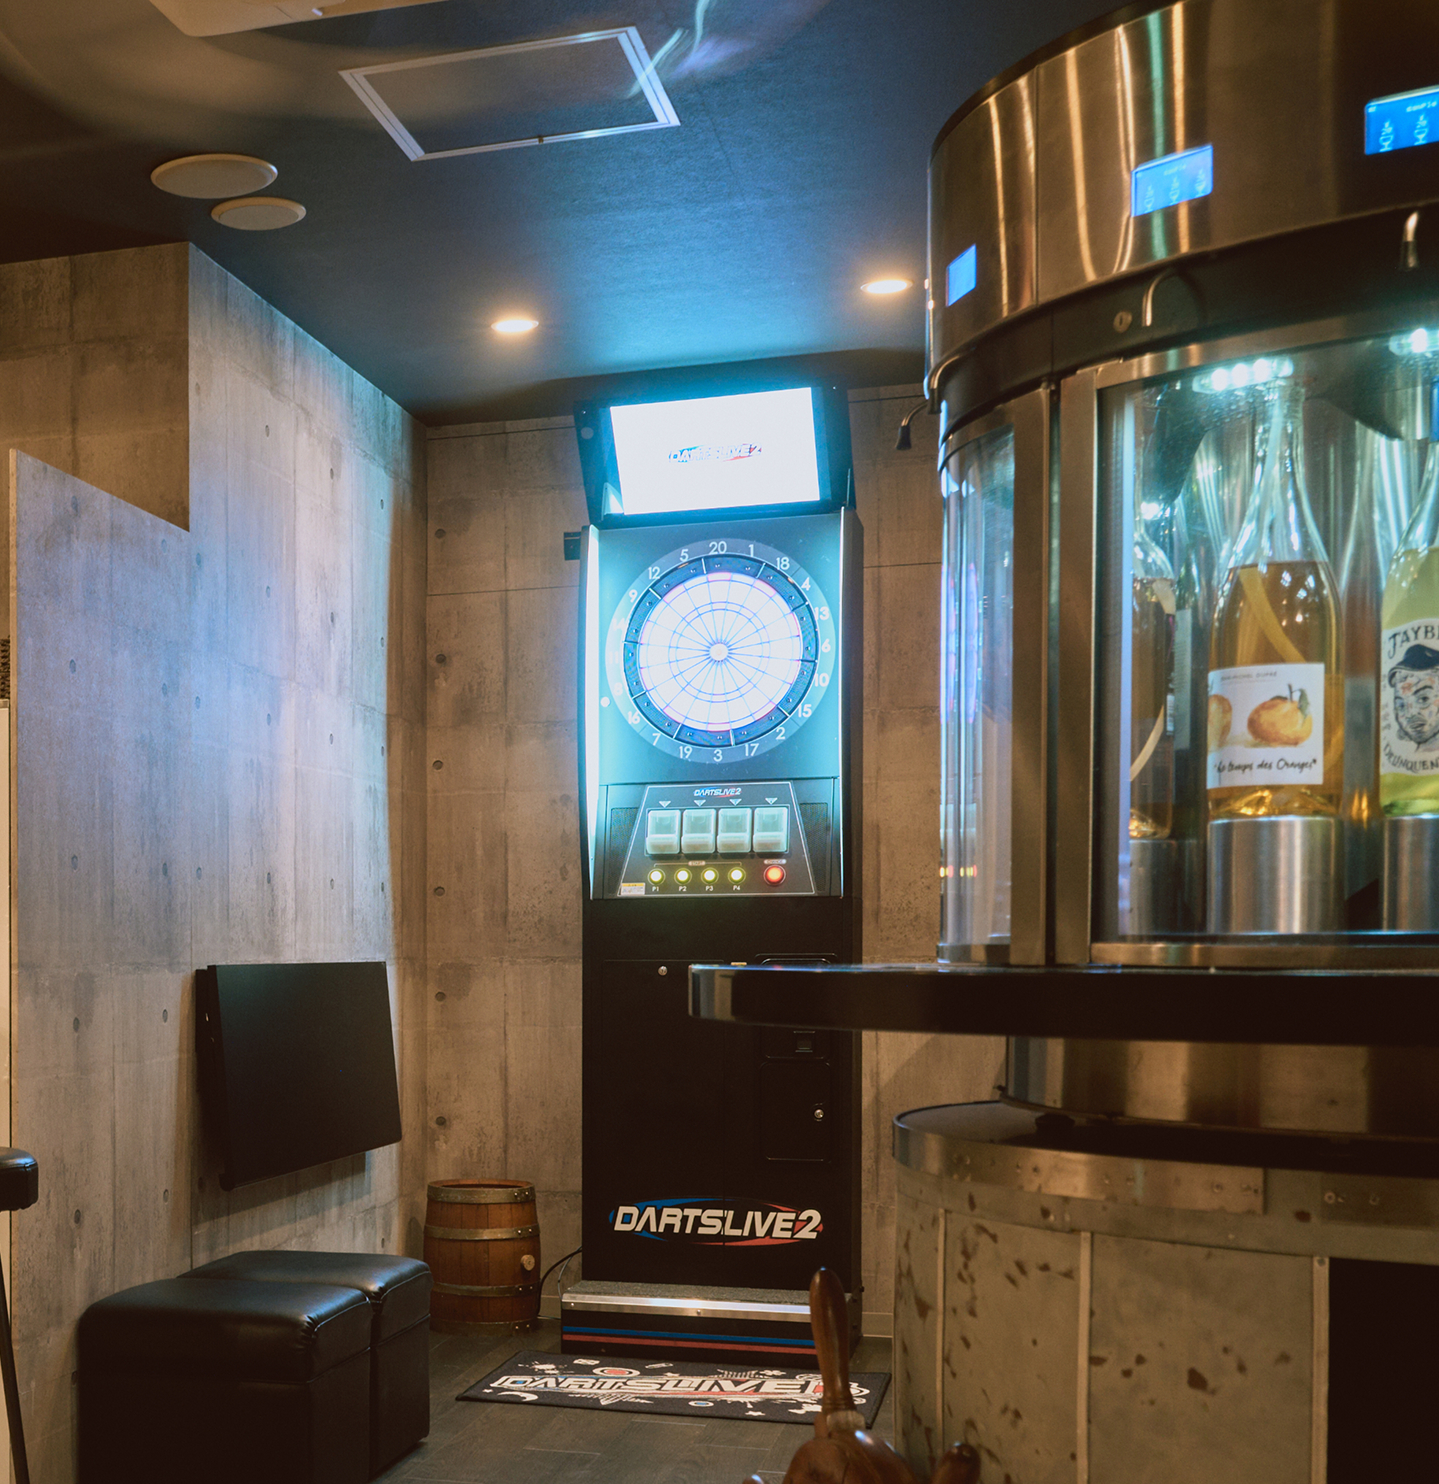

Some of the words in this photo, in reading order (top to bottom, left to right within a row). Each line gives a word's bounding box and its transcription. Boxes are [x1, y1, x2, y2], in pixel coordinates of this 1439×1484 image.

[709, 541, 727, 554] 20
[680, 549, 689, 562] 5
[776, 557, 790, 570] 18
[648, 567, 660, 580] 12
[801, 577, 811, 591] 4
[628, 589, 638, 603] 9
[814, 607, 830, 620] 13
[821, 639, 831, 652] 6
[814, 673, 830, 687] 10
[614, 682, 623, 696] 8
[628, 711, 641, 724] 16
[798, 704, 812, 718] 15
[652, 733, 661, 746] 7
[775, 728, 786, 740] 2
[679, 746, 693, 759] 19
[713, 748, 723, 762] 3
[744, 743, 759, 757] 17
[694, 788, 742, 797] DARTSLIVE2
[613, 1205, 823, 1240] DARTSLIVE2
